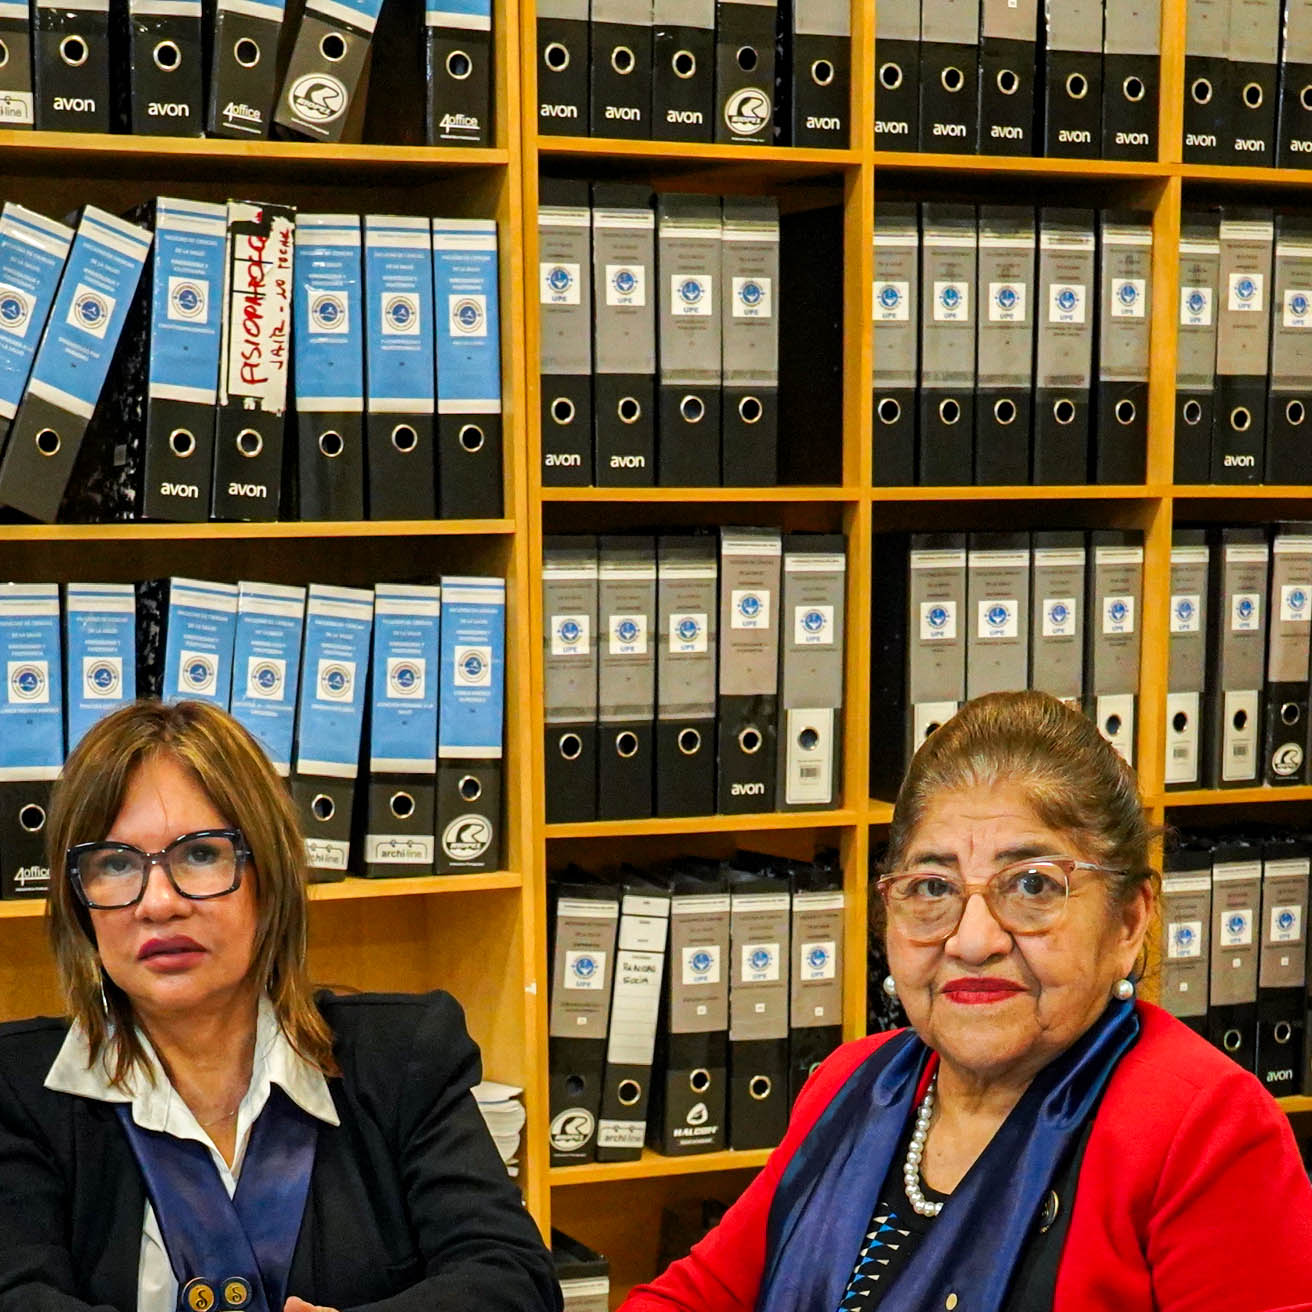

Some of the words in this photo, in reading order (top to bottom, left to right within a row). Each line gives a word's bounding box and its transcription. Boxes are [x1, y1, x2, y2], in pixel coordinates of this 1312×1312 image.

[53, 97, 96, 112] avon
[147, 102, 190, 117] avon
[540, 104, 578, 118] avon
[605, 106, 641, 121] avon
[666, 109, 703, 124] avon
[806, 116, 841, 130] avon
[874, 118, 908, 134] avon
[932, 123, 967, 137] avon
[990, 125, 1023, 139] avon
[1058, 130, 1091, 143] avon
[1115, 132, 1149, 145] avon
[1185, 134, 1217, 147] avon
[1234, 138, 1265, 152] avon
[545, 453, 581, 466] avon
[610, 455, 645, 468] avon
[1223, 455, 1255, 467] avon
[160, 482, 199, 498] avon
[228, 482, 267, 498] avon
[731, 783, 765, 796] avon
[13, 865, 52, 887] 4offic
[1266, 1069, 1293, 1082] avon
